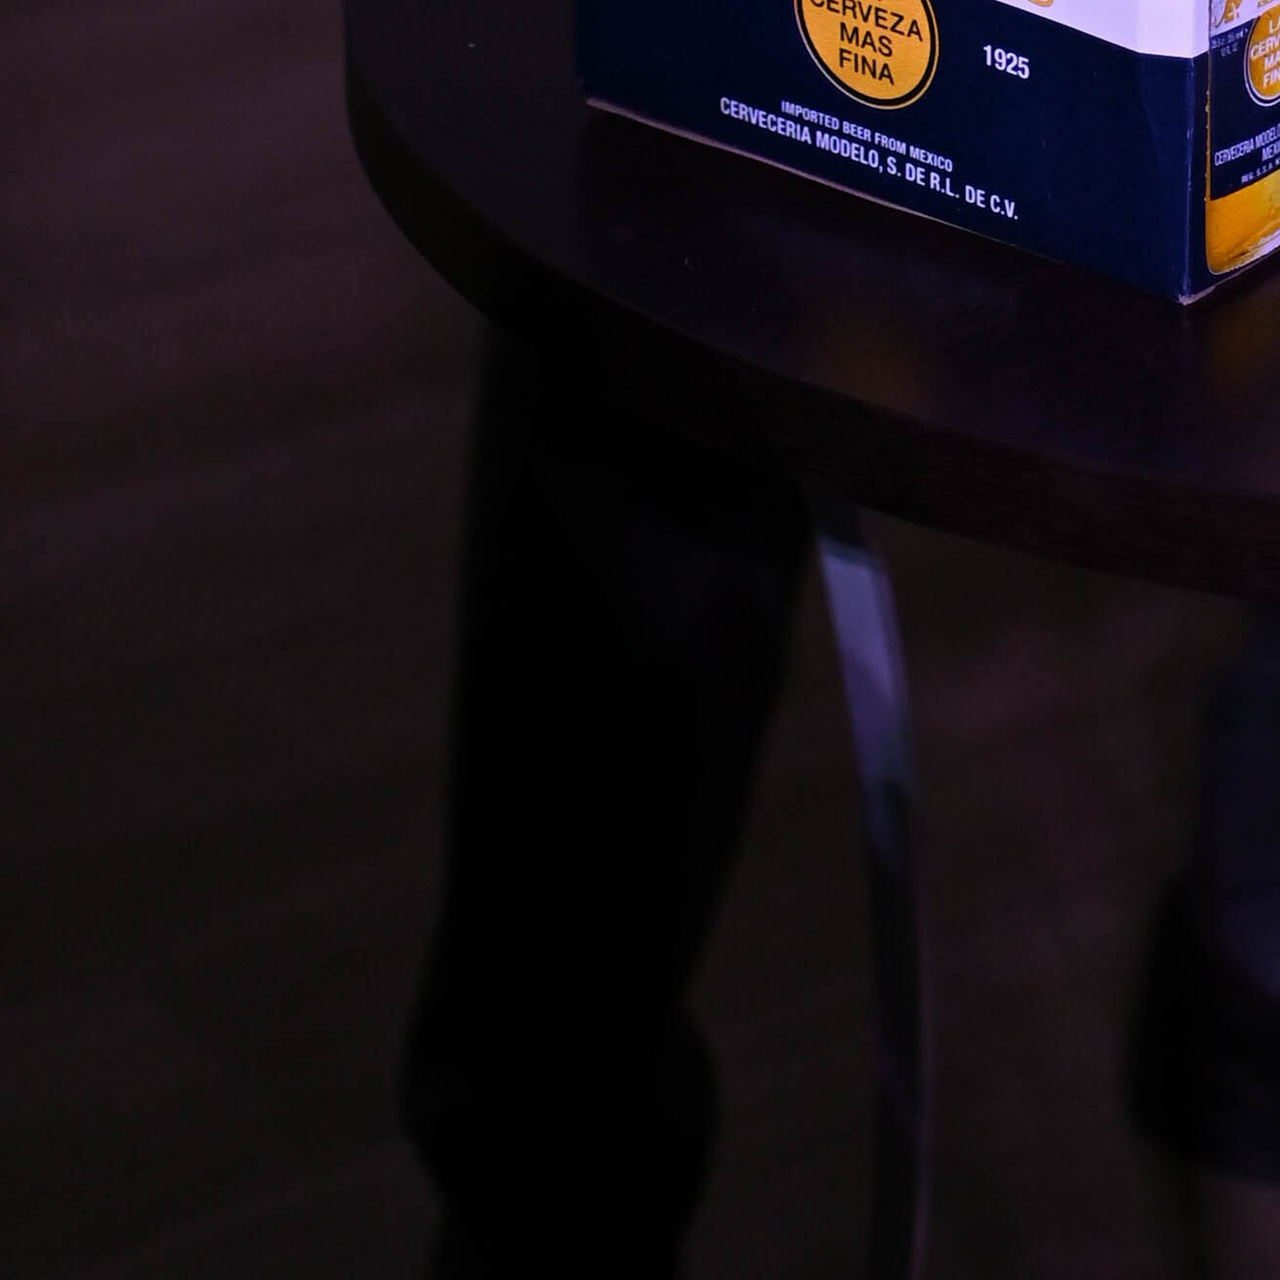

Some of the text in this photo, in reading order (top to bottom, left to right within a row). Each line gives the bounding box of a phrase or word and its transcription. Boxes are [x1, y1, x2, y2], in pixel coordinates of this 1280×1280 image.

[839, 22, 894, 58] MAS
[838, 48, 895, 86] FINA
[983, 44, 1031, 79] 1925
[780, 99, 953, 173] IMPORTED BEER FROM MEXICO
[720, 96, 1019, 220] CERVECERIA MODELO, S. DE R.L. DE C.V.
